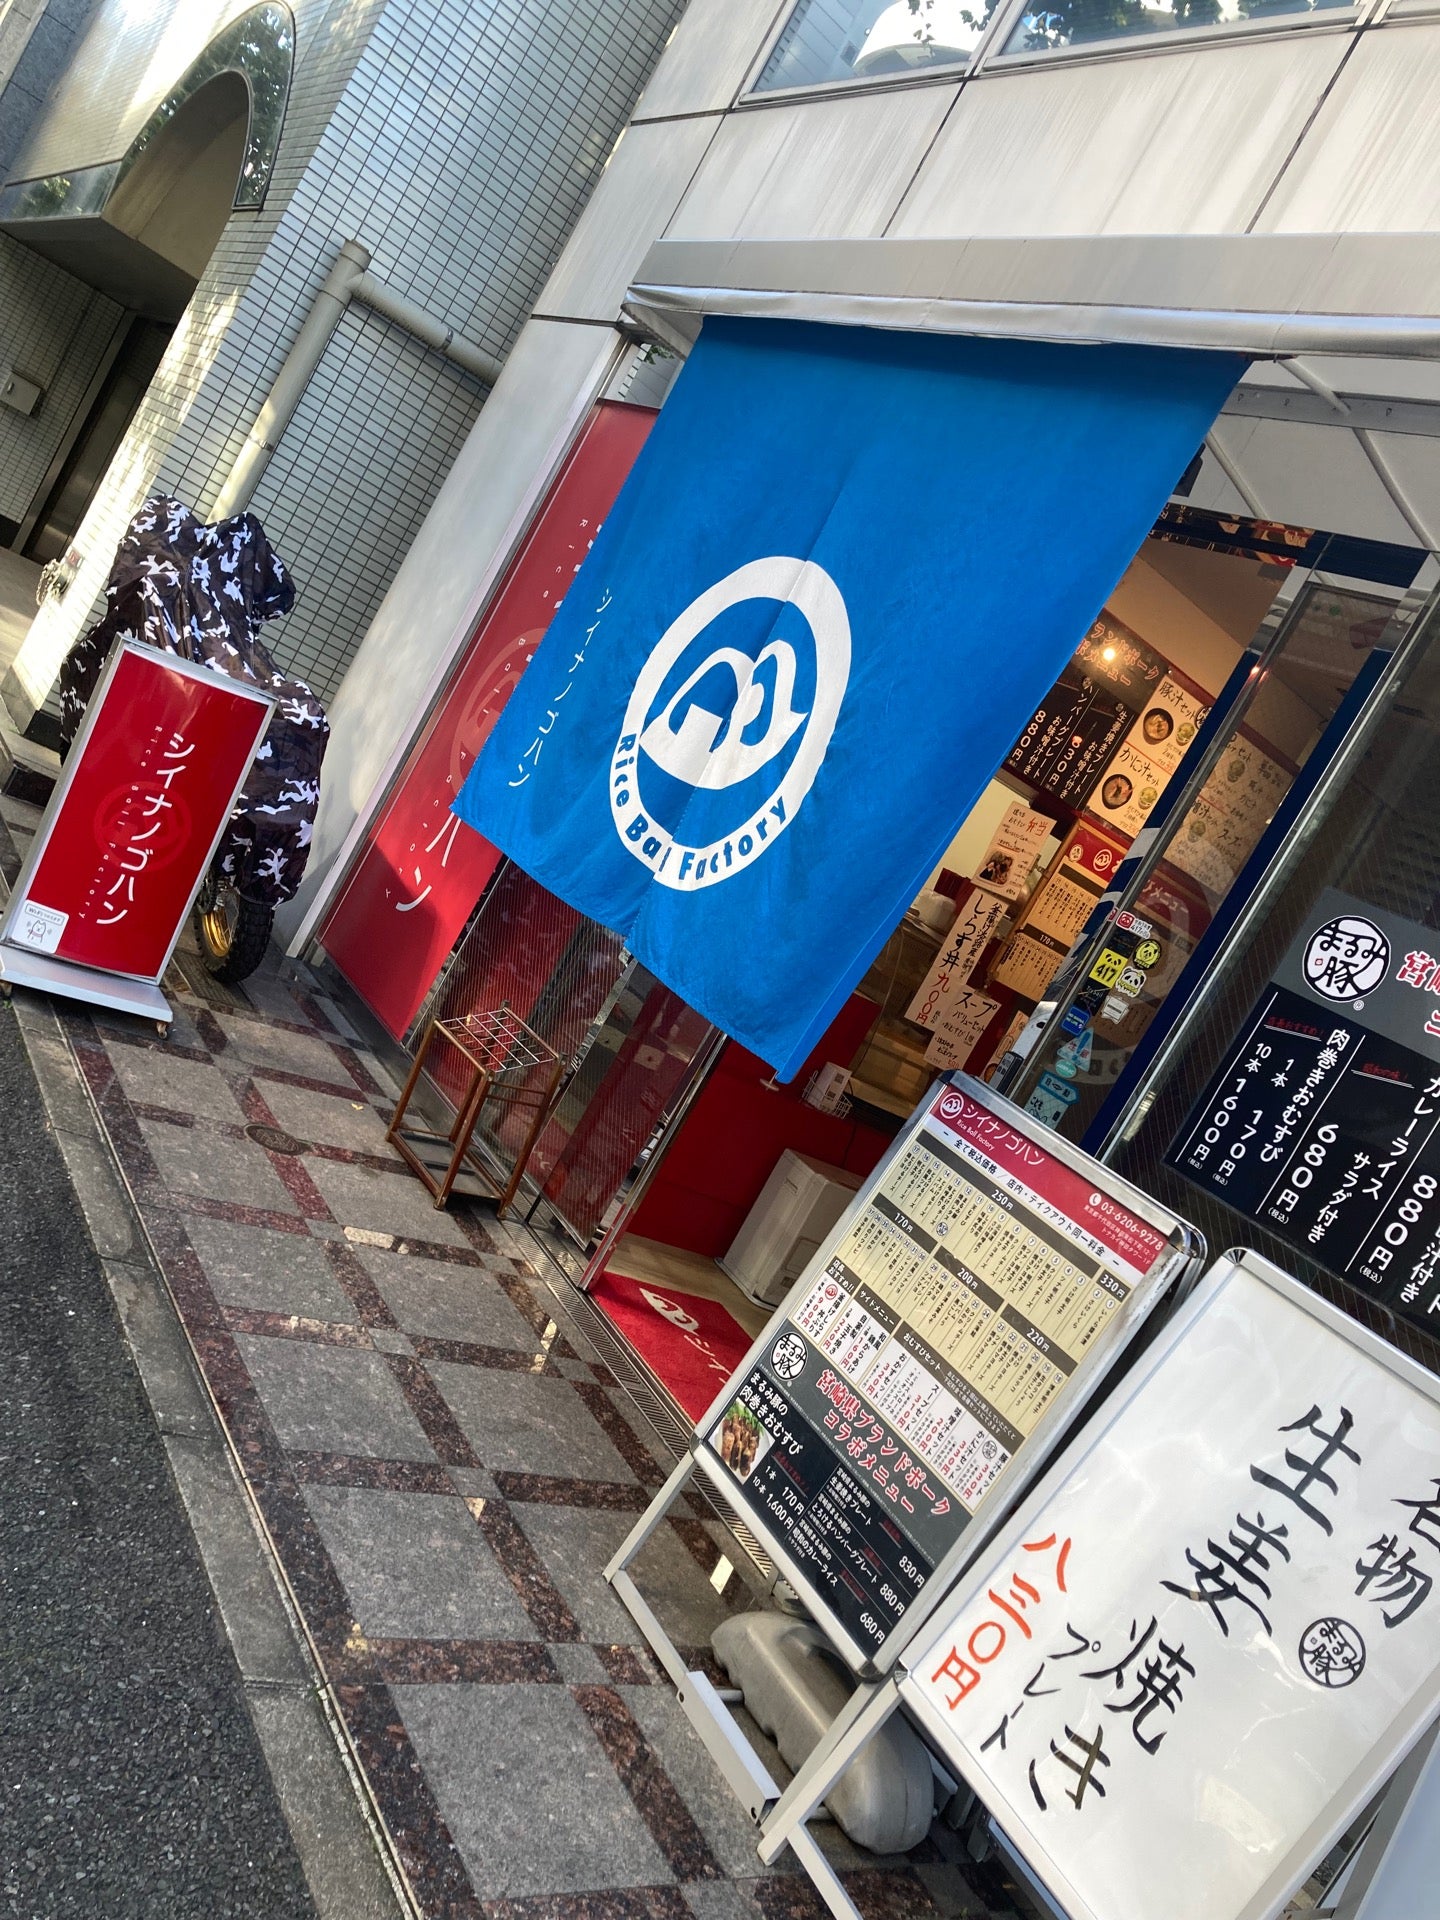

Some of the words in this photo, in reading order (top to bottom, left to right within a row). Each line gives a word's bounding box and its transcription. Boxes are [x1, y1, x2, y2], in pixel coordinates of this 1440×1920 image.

[508, 587, 613, 788] シイナノゴハン
[1010, 707, 1048, 762] 880円
[95, 732, 196, 925] シイナノゴハン
[614, 733, 638, 808] Rice
[678, 795, 788, 881] Factory
[938, 893, 992, 975] しらす丼
[1093, 962, 1117, 984] 417
[953, 987, 998, 1024] スープ
[1244, 1042, 1273, 1074] 10本
[1270, 1058, 1295, 1089] 1本
[1193, 1077, 1248, 1162] 1600円
[1259, 1028, 1351, 1163] 肉巻きおむすび
[955, 1118, 968, 1131] Rice
[964, 1126, 978, 1138] Ball
[973, 1133, 996, 1152] Factory
[960, 1102, 1048, 1169] シイナノゴハン
[1218, 1108, 1264, 1178] 170円
[1275, 1123, 1340, 1213] 680円
[892, 1212, 915, 1234] 170円
[989, 1188, 1016, 1211] 250円
[1307, 1151, 1372, 1244] サラダ付き
[1367, 1173, 1440, 1272] 880円
[1098, 1200, 1166, 1252] 03-6206-9278
[955, 1266, 980, 1290] 200円
[1098, 1273, 1127, 1299] 330円
[800, 1295, 824, 1328] 900円
[822, 1317, 846, 1350] 220円
[857, 1289, 897, 1327] サイドメニュー
[840, 1335, 865, 1369] 160円
[901, 1331, 943, 1373] おむすびセット
[1024, 1326, 1052, 1353] 220円
[749, 1370, 790, 1418] まるみ豚の
[865, 1361, 891, 1396] 320円
[871, 1351, 907, 1402] おかずセット
[738, 1382, 804, 1460] 肉巻きおむすび
[895, 1392, 922, 1429] 310円
[902, 1383, 940, 1434] スープセット
[917, 1415, 944, 1452] 200円
[923, 1405, 962, 1459] 味噌汁セット
[813, 1366, 957, 1522] 宮崎県ブランドポーク
[819, 1406, 921, 1519] コラボメニュー
[939, 1438, 967, 1476] 330円
[946, 1428, 985, 1482] かに汁セット
[750, 1474, 767, 1496] 10本
[763, 1491, 795, 1532] 1,600円
[763, 1464, 777, 1482] 1本
[779, 1484, 805, 1517] 170円
[828, 1474, 874, 1528] 生姜焼きプレート
[961, 1462, 990, 1500] 330円
[809, 1501, 880, 1586] とろけるハンバーグプレート
[897, 1554, 926, 1589] 830円
[878, 1582, 906, 1617] 880円
[1027, 1402, 1363, 1814] 生姜焼き
[857, 1609, 886, 1646] 680円
[979, 1621, 1103, 1755] プレート
